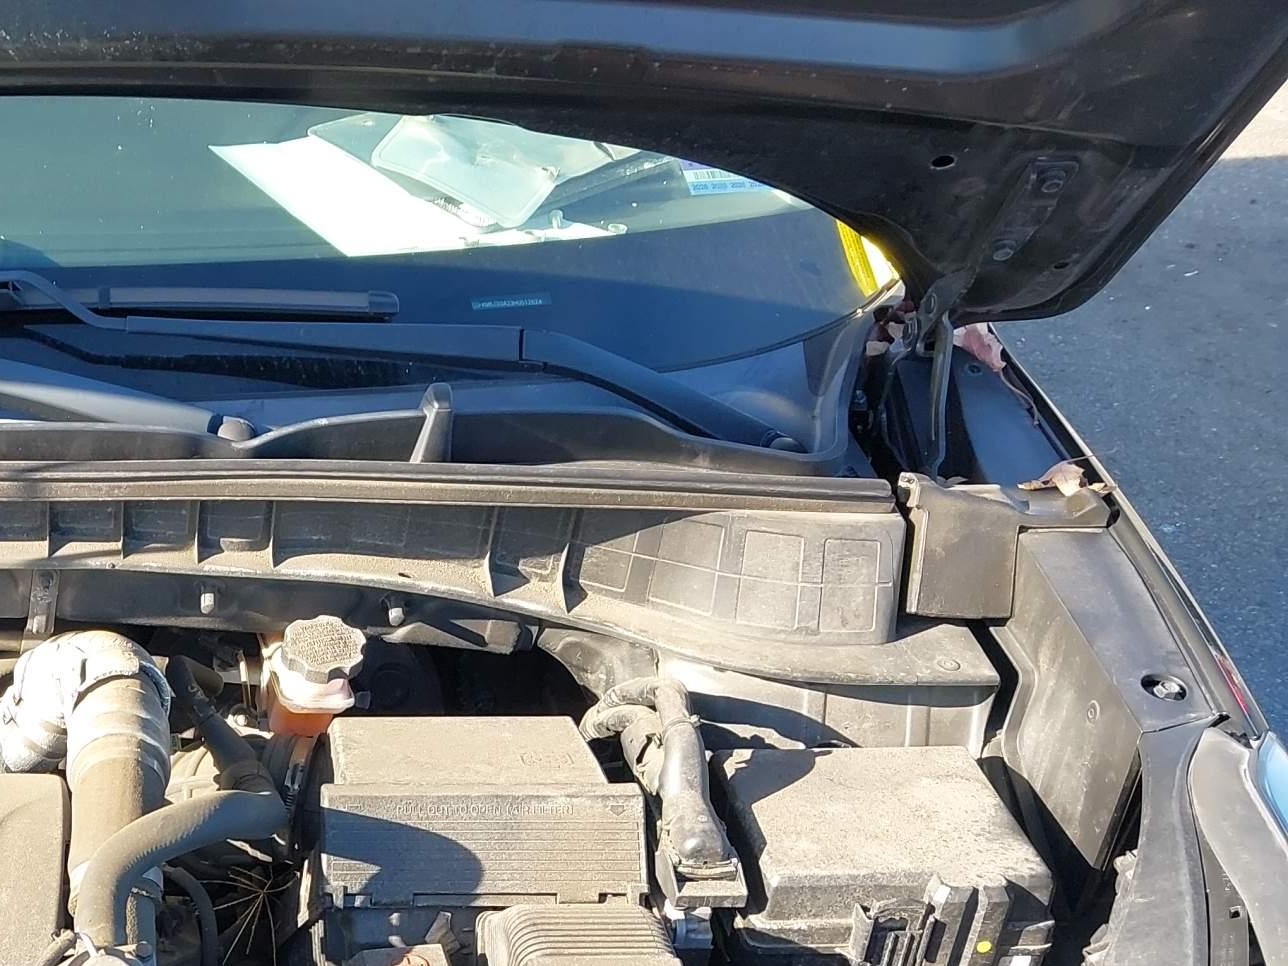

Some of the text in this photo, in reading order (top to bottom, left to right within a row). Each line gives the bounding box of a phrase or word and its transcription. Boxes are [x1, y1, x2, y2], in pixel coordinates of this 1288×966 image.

[396, 803, 423, 816] PULL
[427, 803, 450, 816] OUT
[453, 803, 467, 816] TO
[470, 803, 500, 816] OPEN
